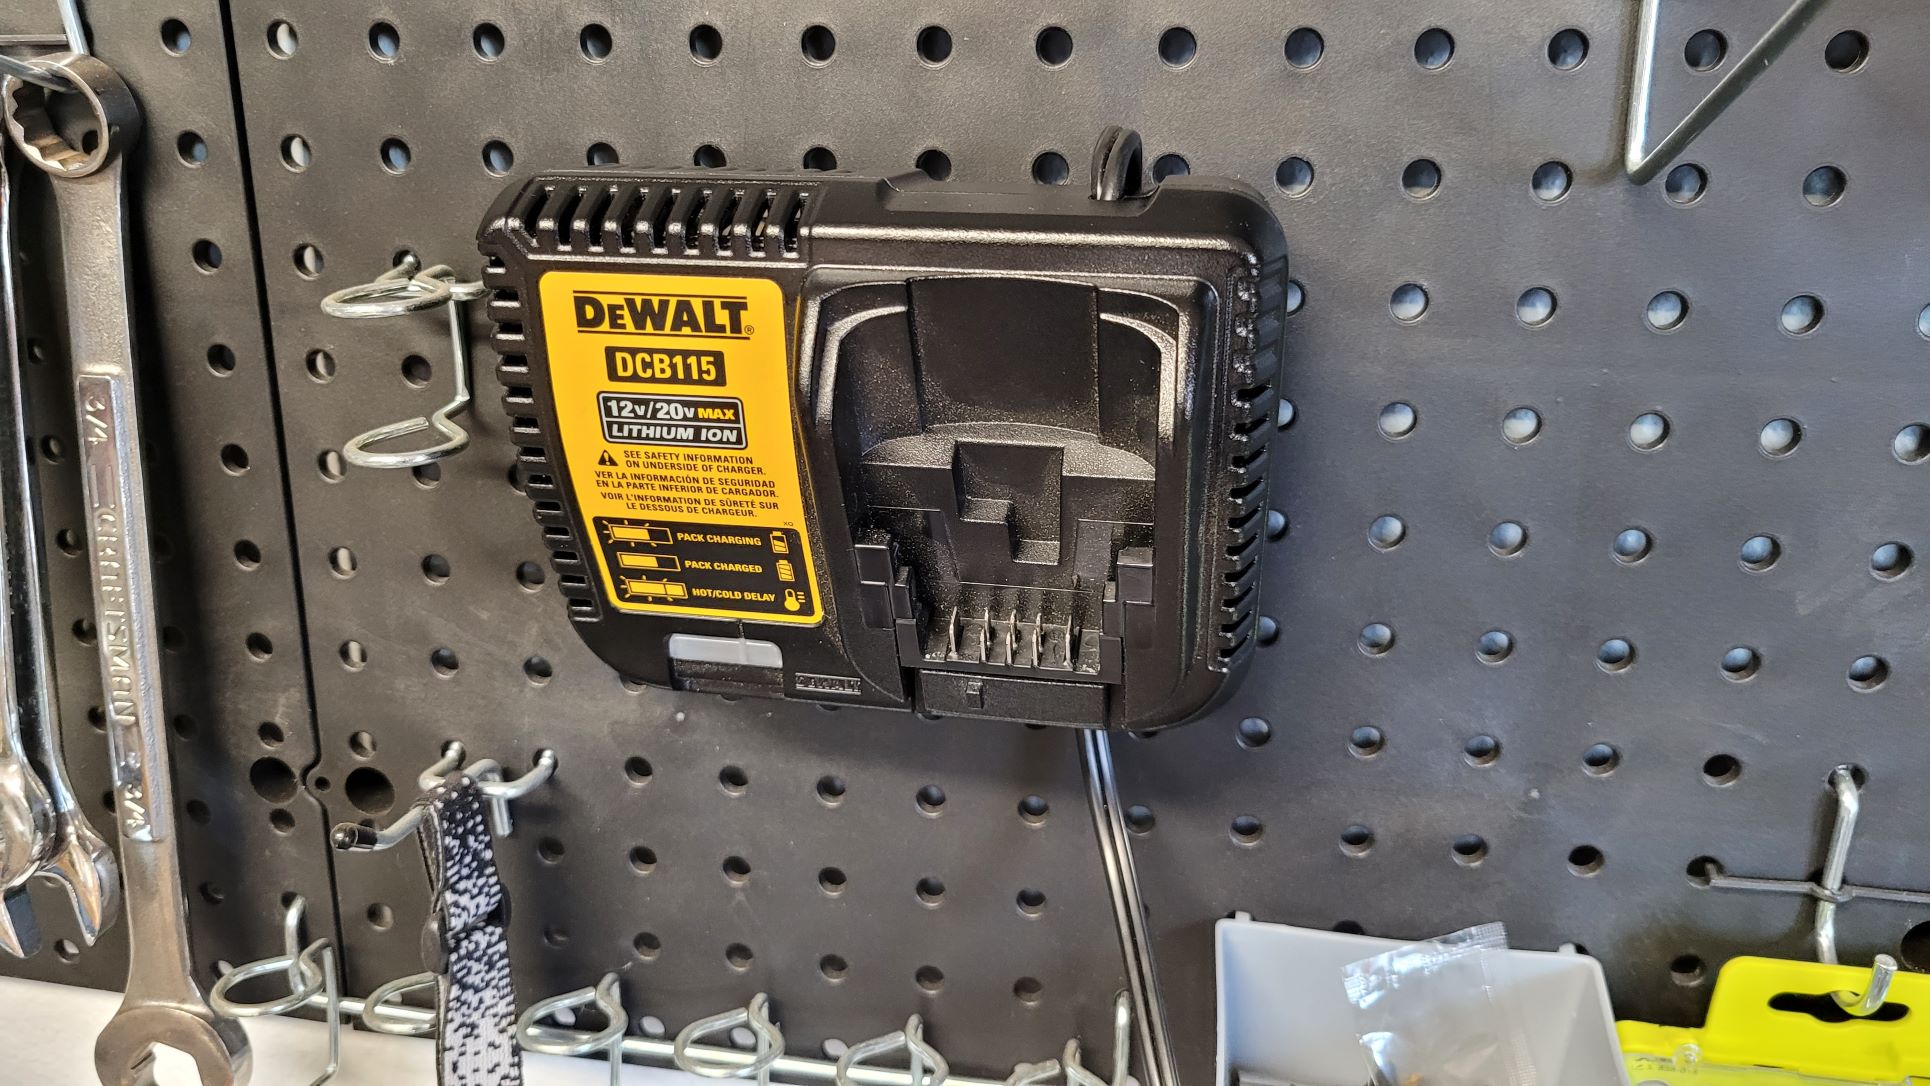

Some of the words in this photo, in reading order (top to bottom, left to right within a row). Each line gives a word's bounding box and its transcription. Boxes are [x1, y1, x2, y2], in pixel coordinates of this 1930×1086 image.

[615, 351, 716, 381] DCB115
[85, 394, 108, 446] 3/4
[698, 408, 736, 421] MAX
[611, 423, 693, 441] LITHIUM
[700, 428, 738, 443] ION
[624, 450, 641, 459] SEE
[644, 451, 680, 461] SAFETY
[683, 453, 753, 464] INFORMATION
[626, 460, 640, 468] ON
[642, 461, 699, 471] UNDERSIDE
[702, 464, 714, 472] OF
[717, 465, 766, 475] CHARGER.
[594, 470, 613, 479] VER
[616, 472, 628, 480] LA
[630, 473, 699, 484] INFORMACIÓN
[703, 477, 715, 485] DE
[718, 478, 775, 488] SEGURIDAD
[596, 480, 609, 488] EN
[626, 481, 657, 491] PARTE
[659, 483, 703, 493] INFERIOR
[706, 486, 719, 494] DE
[721, 487, 779, 498] CARGADOR.
[601, 492, 624, 500] VOIR
[626, 494, 701, 505] L'INFORMATION
[719, 498, 757, 509] SÛRETÉ
[759, 502, 779, 510] SUR
[626, 502, 637, 510] LE
[639, 503, 684, 513] DESSOUS
[686, 506, 700, 514] DE
[702, 507, 757, 517] CHARGEUR.
[676, 533, 705, 542] PACK
[706, 534, 762, 546] CHARGING
[684, 560, 712, 570] PACK
[713, 562, 763, 573] CHARGED
[692, 588, 742, 599] HOT/COLD
[744, 591, 776, 602] DELAY
